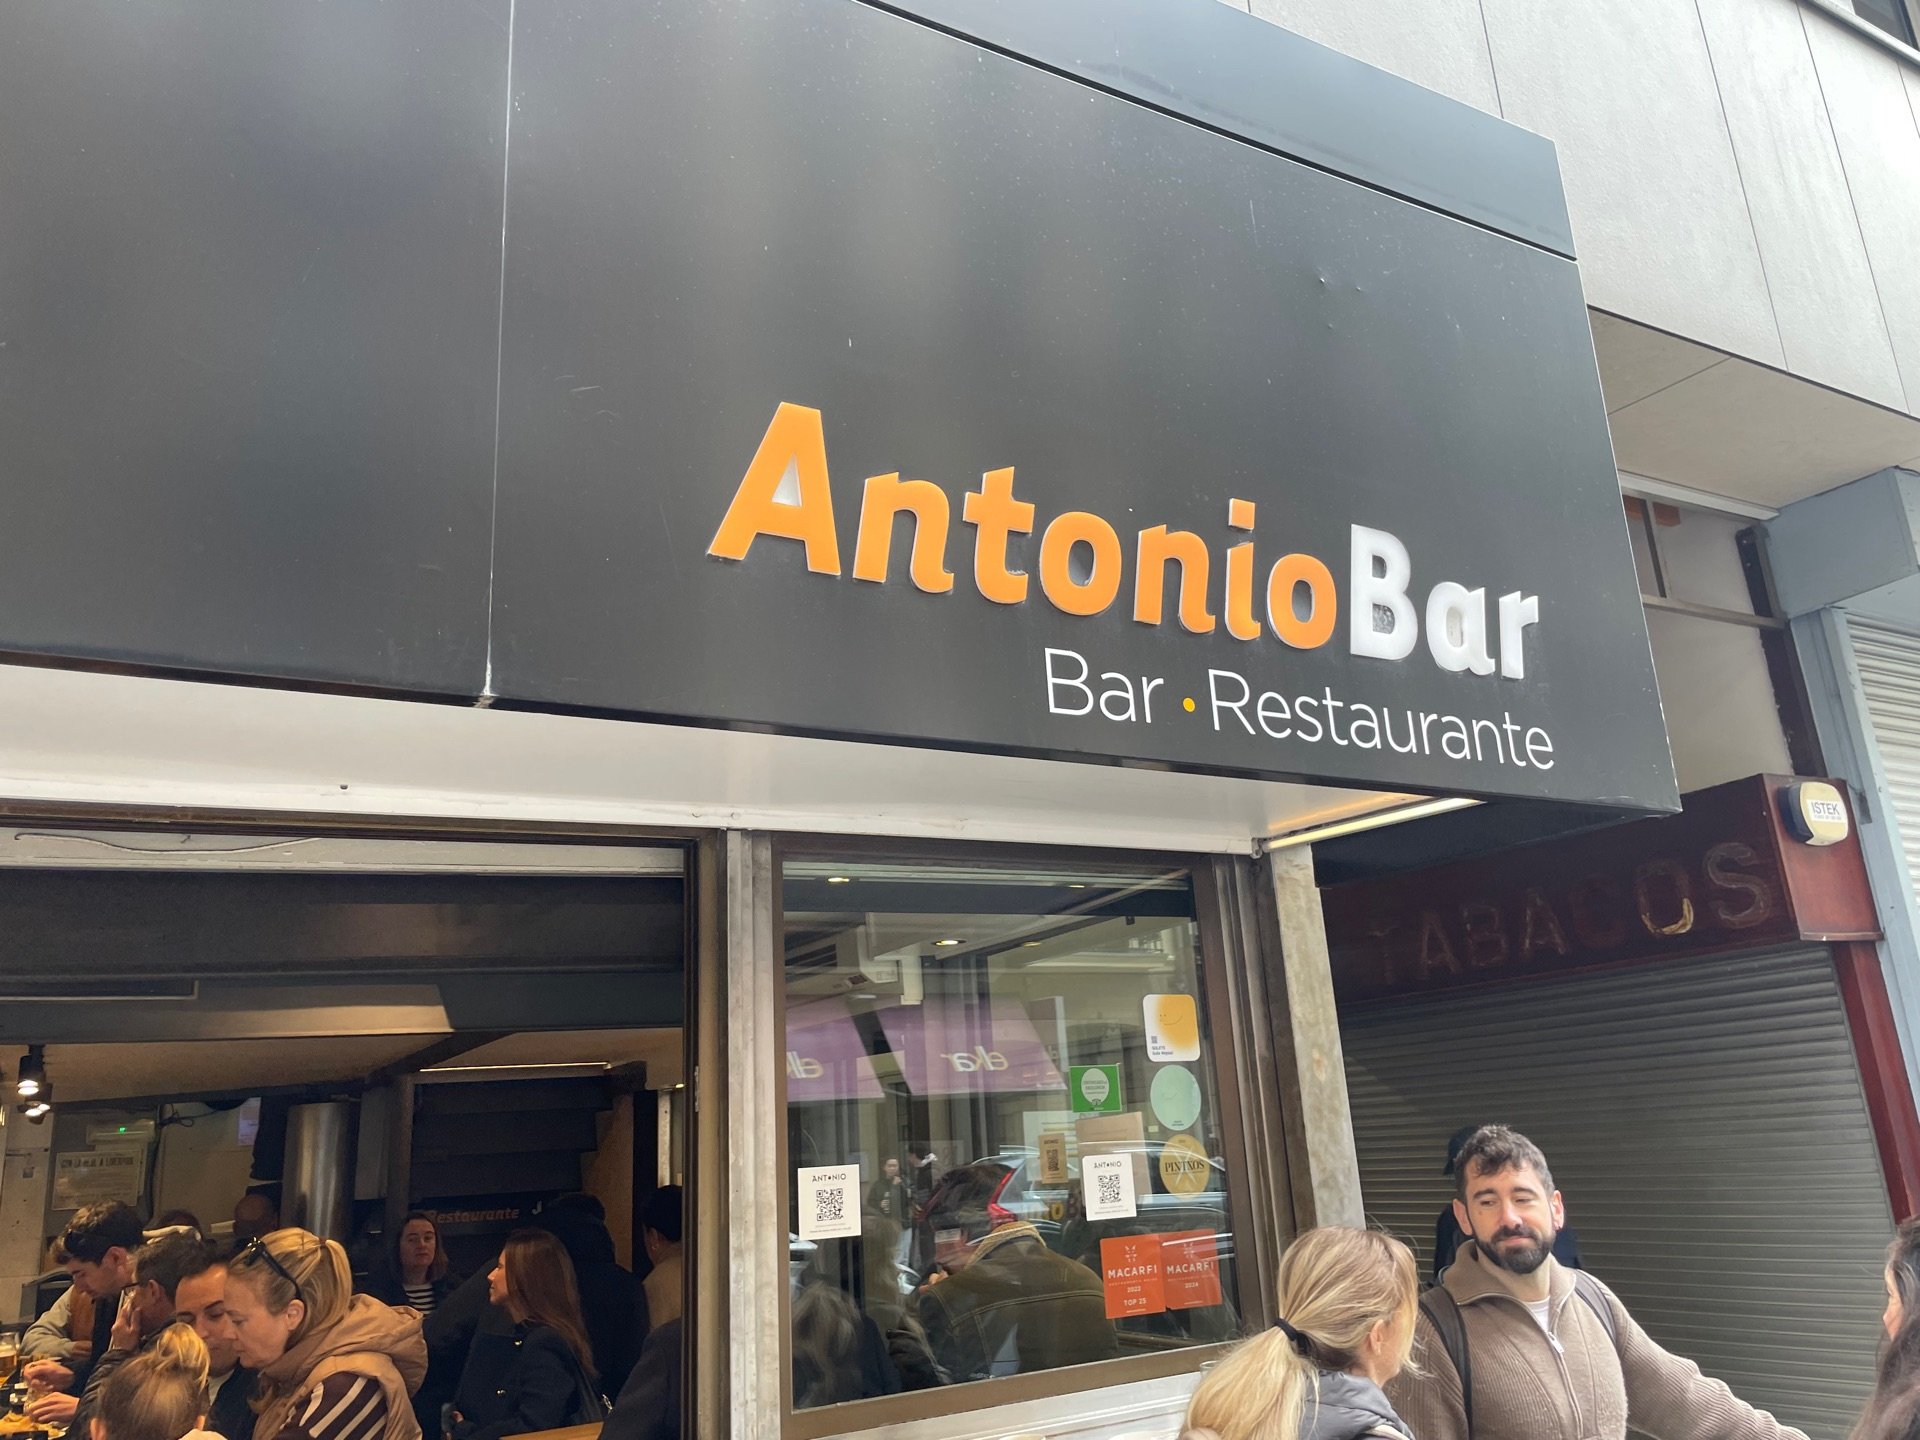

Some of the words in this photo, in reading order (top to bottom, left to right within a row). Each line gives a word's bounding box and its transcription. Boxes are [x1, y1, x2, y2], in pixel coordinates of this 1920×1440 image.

[1044, 647, 1164, 724] Bar
[1207, 668, 1555, 771] Restaurante
[1811, 801, 1840, 816] ISTEK
[1358, 841, 1772, 986] TABACOS
[1164, 1159, 1205, 1173] PINTXOS
[1107, 1264, 1158, 1280] MACARFI
[1166, 1260, 1215, 1275] MACARFI
[1123, 1298, 1137, 1307] TOP
